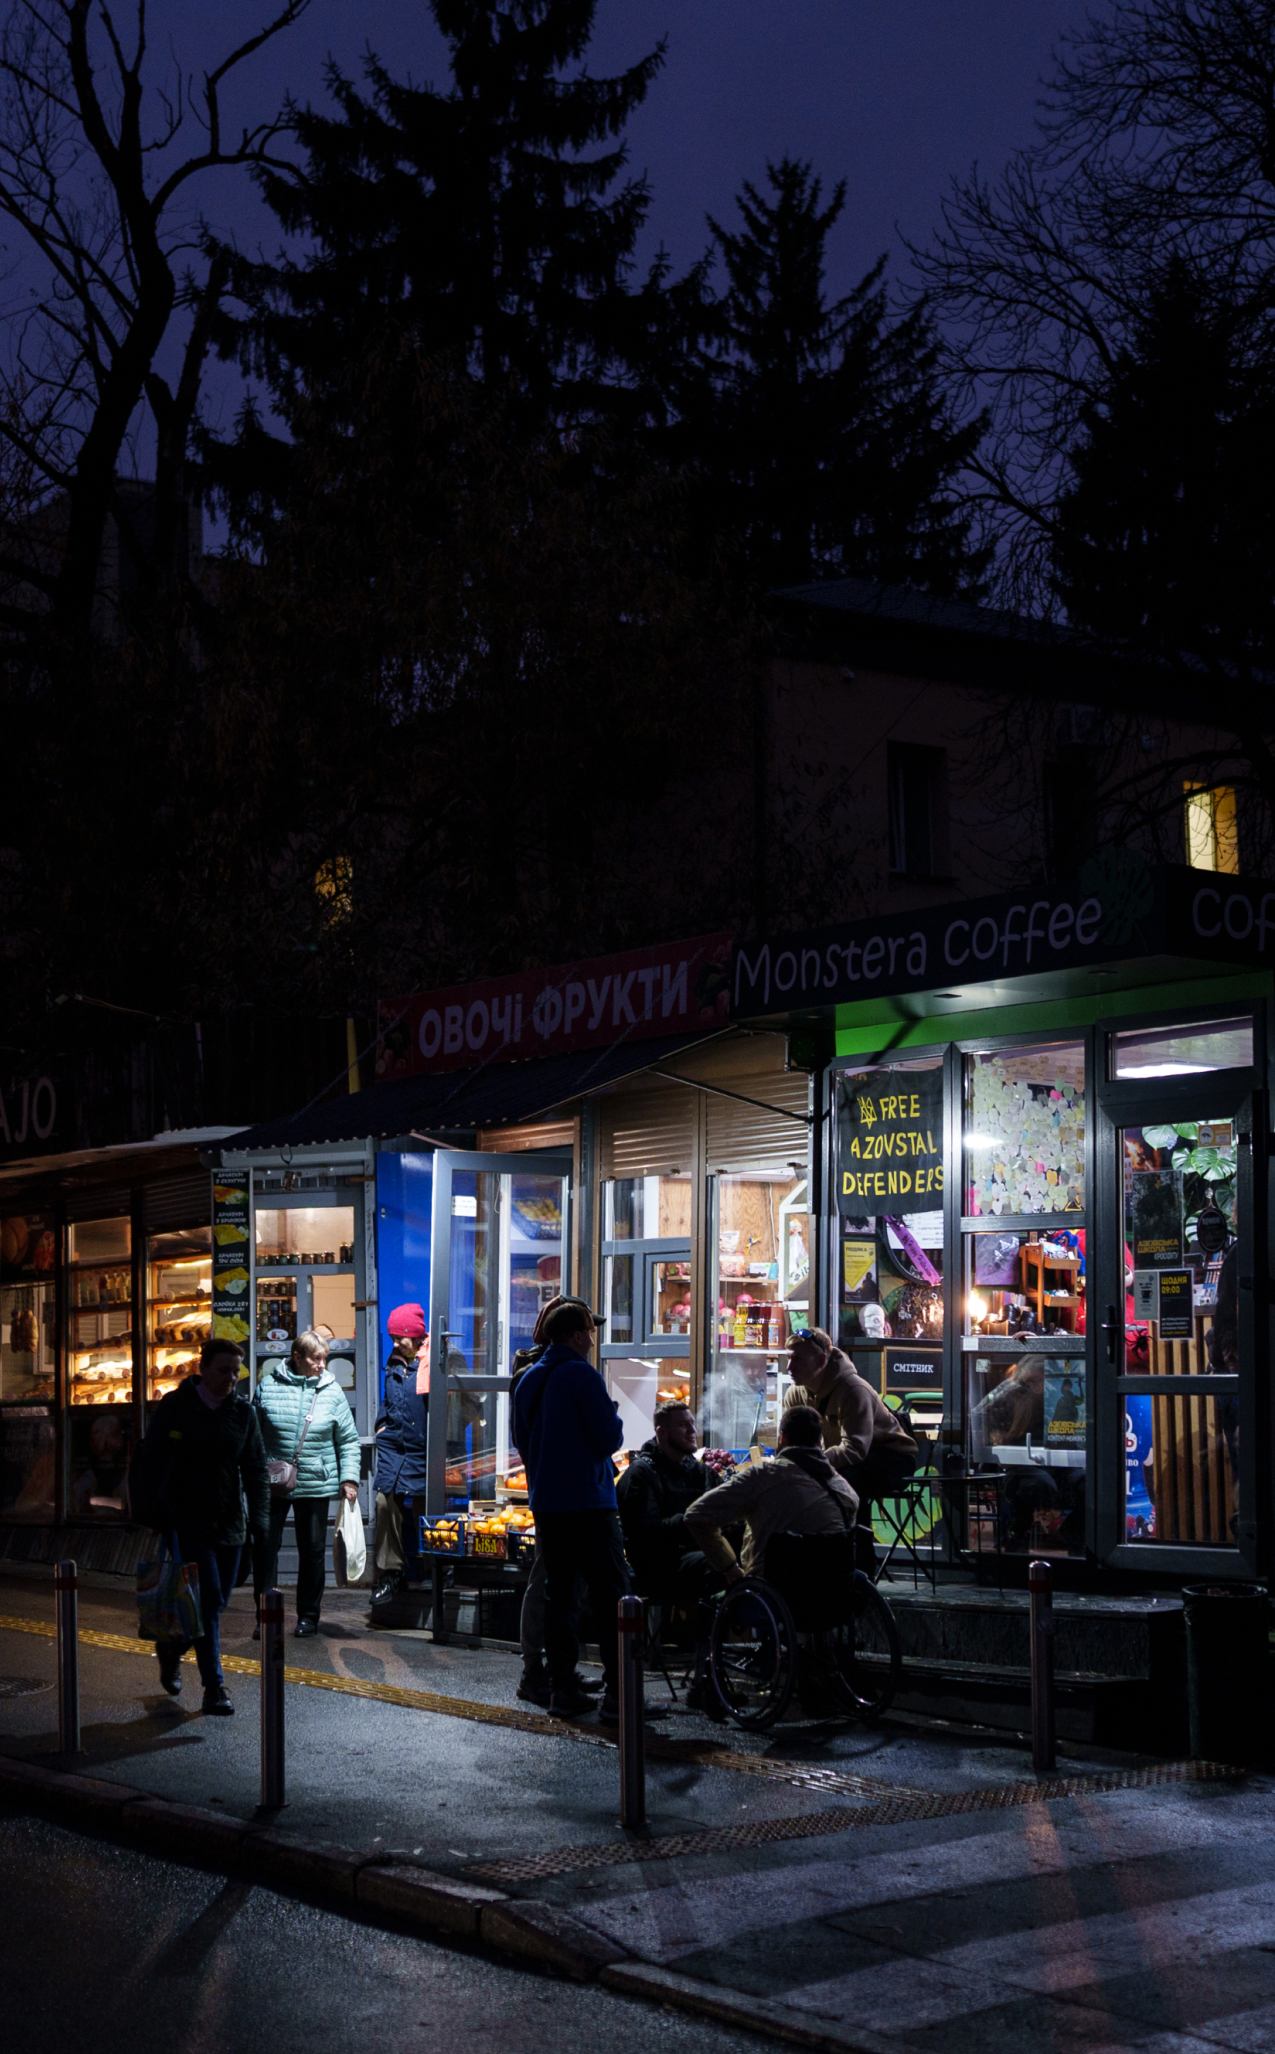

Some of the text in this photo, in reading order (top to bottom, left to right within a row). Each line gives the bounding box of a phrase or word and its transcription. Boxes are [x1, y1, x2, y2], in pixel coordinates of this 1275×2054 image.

[735, 931, 927, 1006] Monstera
[418, 960, 689, 1059] ОВОЧІ ФРУКТИ
[879, 1094, 920, 1121] FREE
[850, 1130, 938, 1159] AZOVSTAL
[842, 1165, 943, 1196] DEFENDERS
[1161, 1276, 1187, 1285] ЩОДНЯ
[1161, 1285, 1180, 1294] 09:00
[893, 1362, 934, 1373] СМІТНИК
